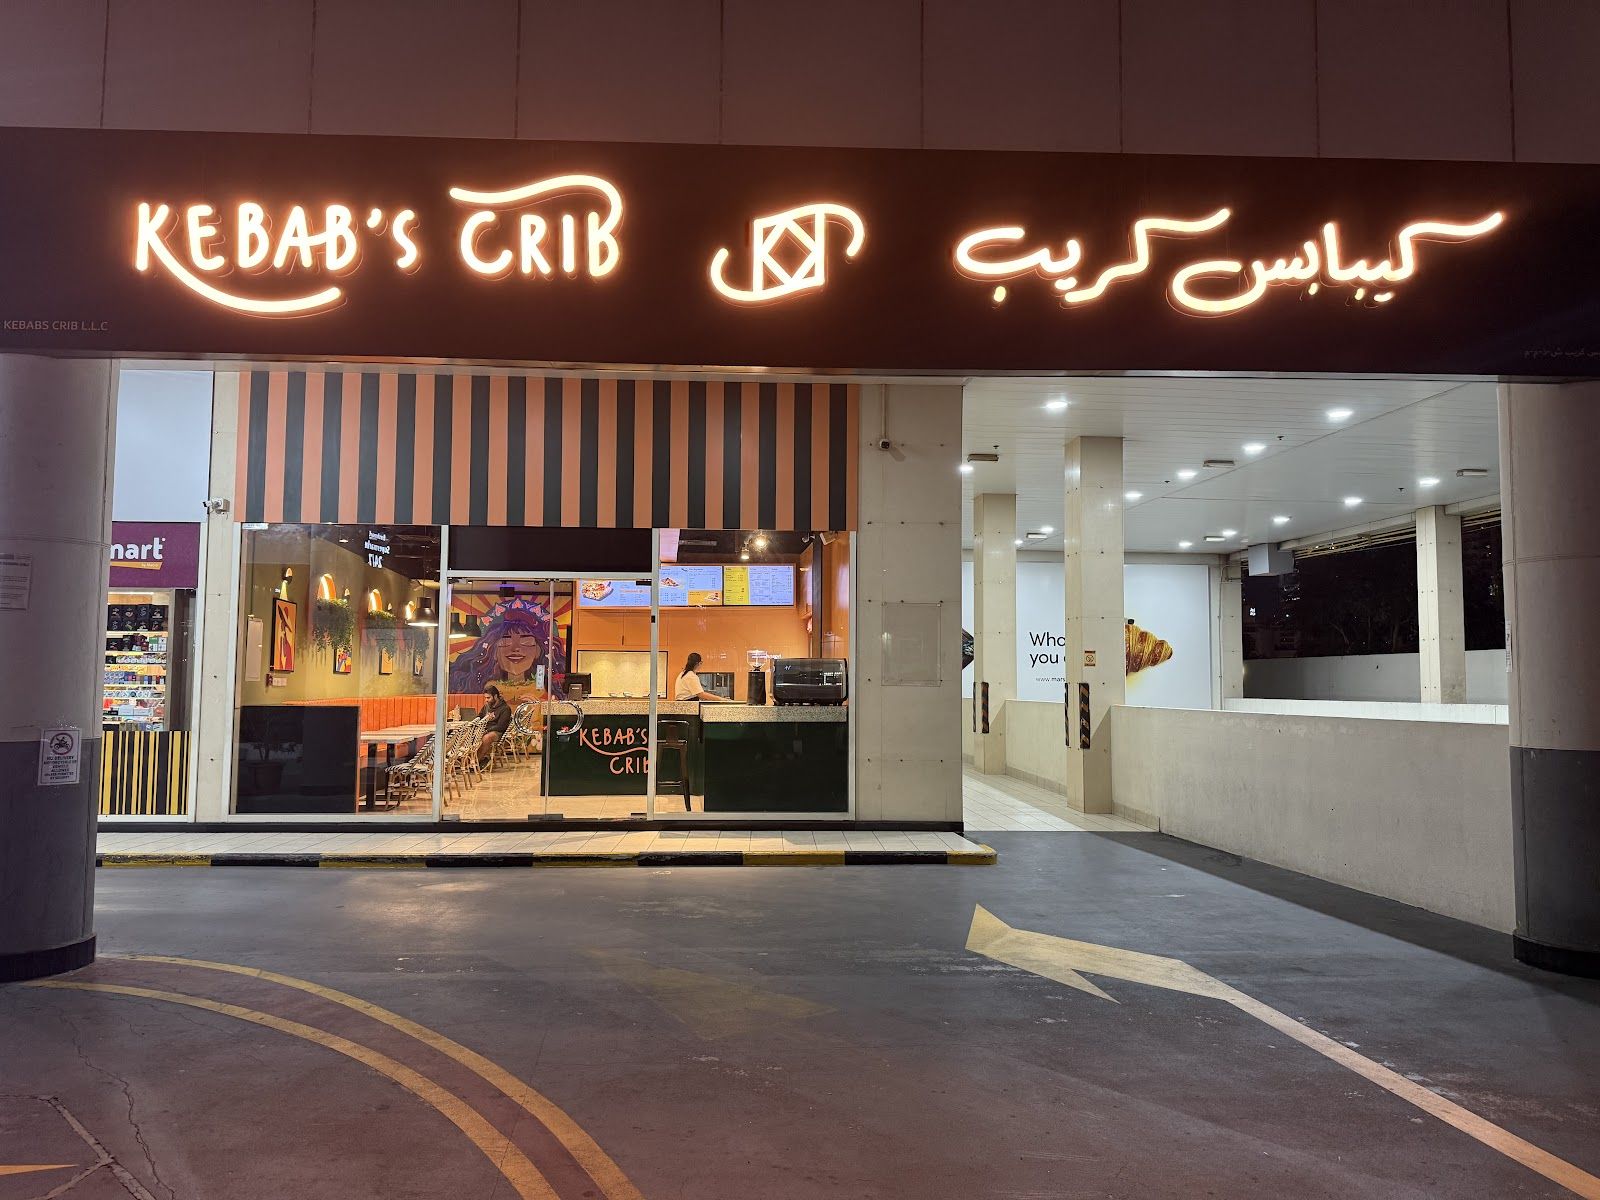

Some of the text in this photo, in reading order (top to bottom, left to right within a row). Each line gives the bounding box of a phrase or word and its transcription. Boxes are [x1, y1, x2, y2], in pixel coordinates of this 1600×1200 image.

[133, 174, 623, 313] KEBAB'S CRIB
[954, 208, 1504, 312] كيبابس كريب
[3, 320, 108, 331] KEBABS CRIB L.L.C
[1029, 653, 1059, 668] you
[579, 727, 648, 755] KEBAB'S
